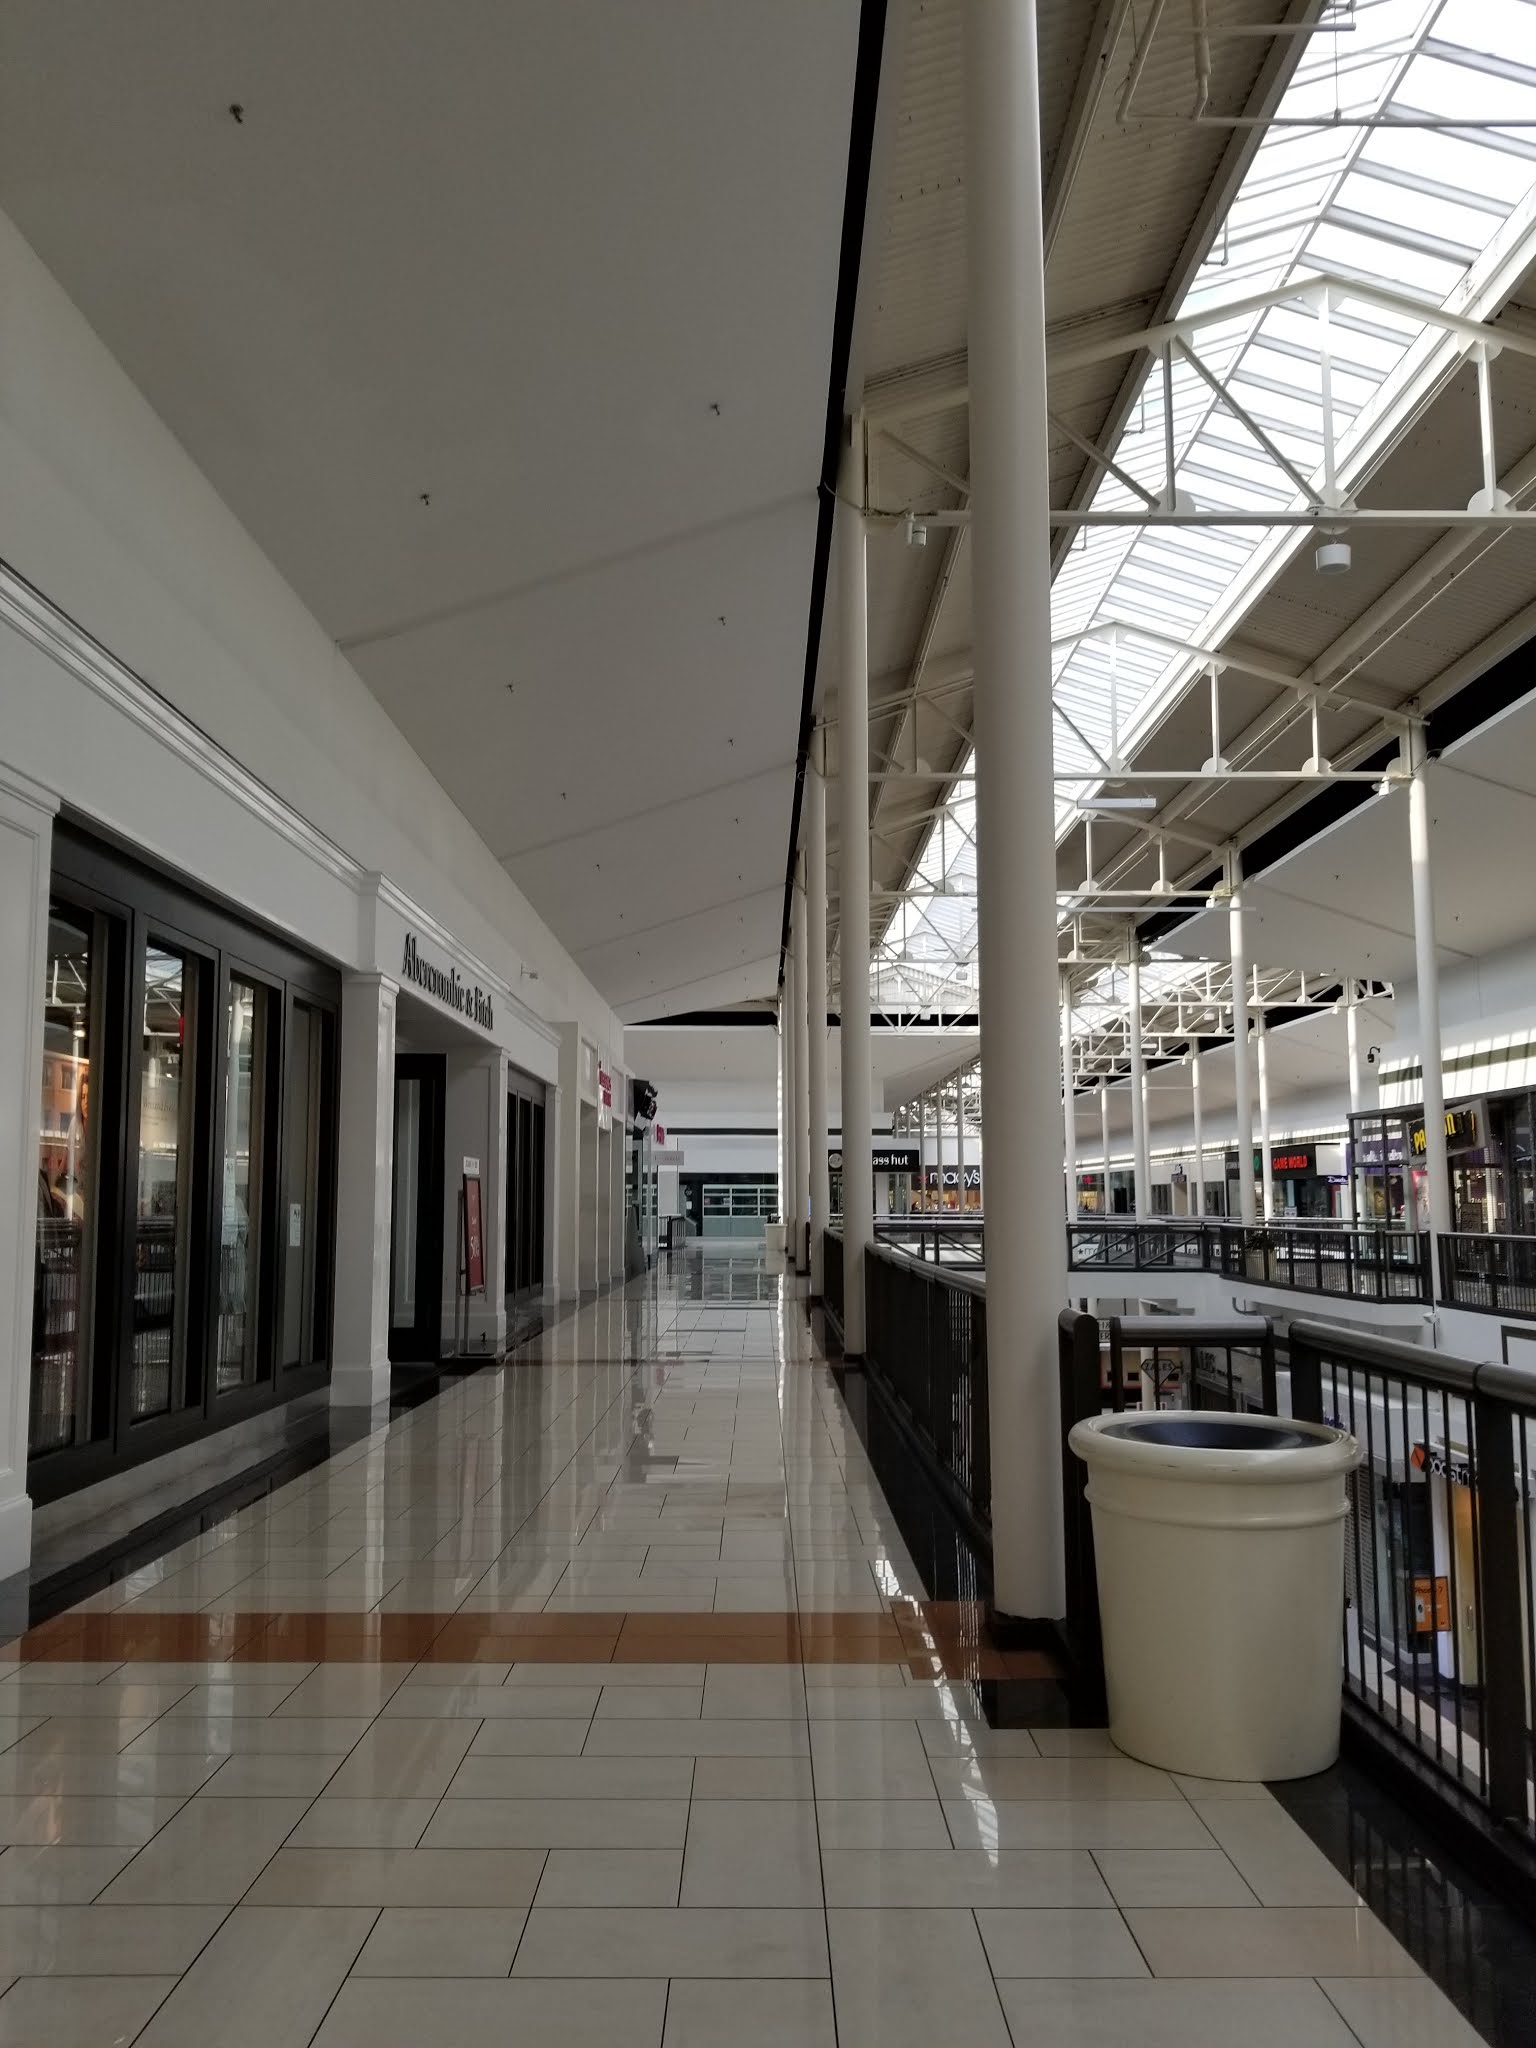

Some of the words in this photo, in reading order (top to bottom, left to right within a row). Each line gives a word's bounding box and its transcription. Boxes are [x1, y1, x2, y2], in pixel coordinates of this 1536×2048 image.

[402, 932, 464, 1012] Abercrombie
[465, 988, 473, 1019] &
[474, 986, 493, 1031] Fitch
[872, 1156, 890, 1166] ass
[891, 1154, 908, 1165] hut
[1273, 1157, 1288, 1170] GAME
[1288, 1154, 1308, 1169] WORLD
[1145, 1362, 1173, 1371] ZAES
